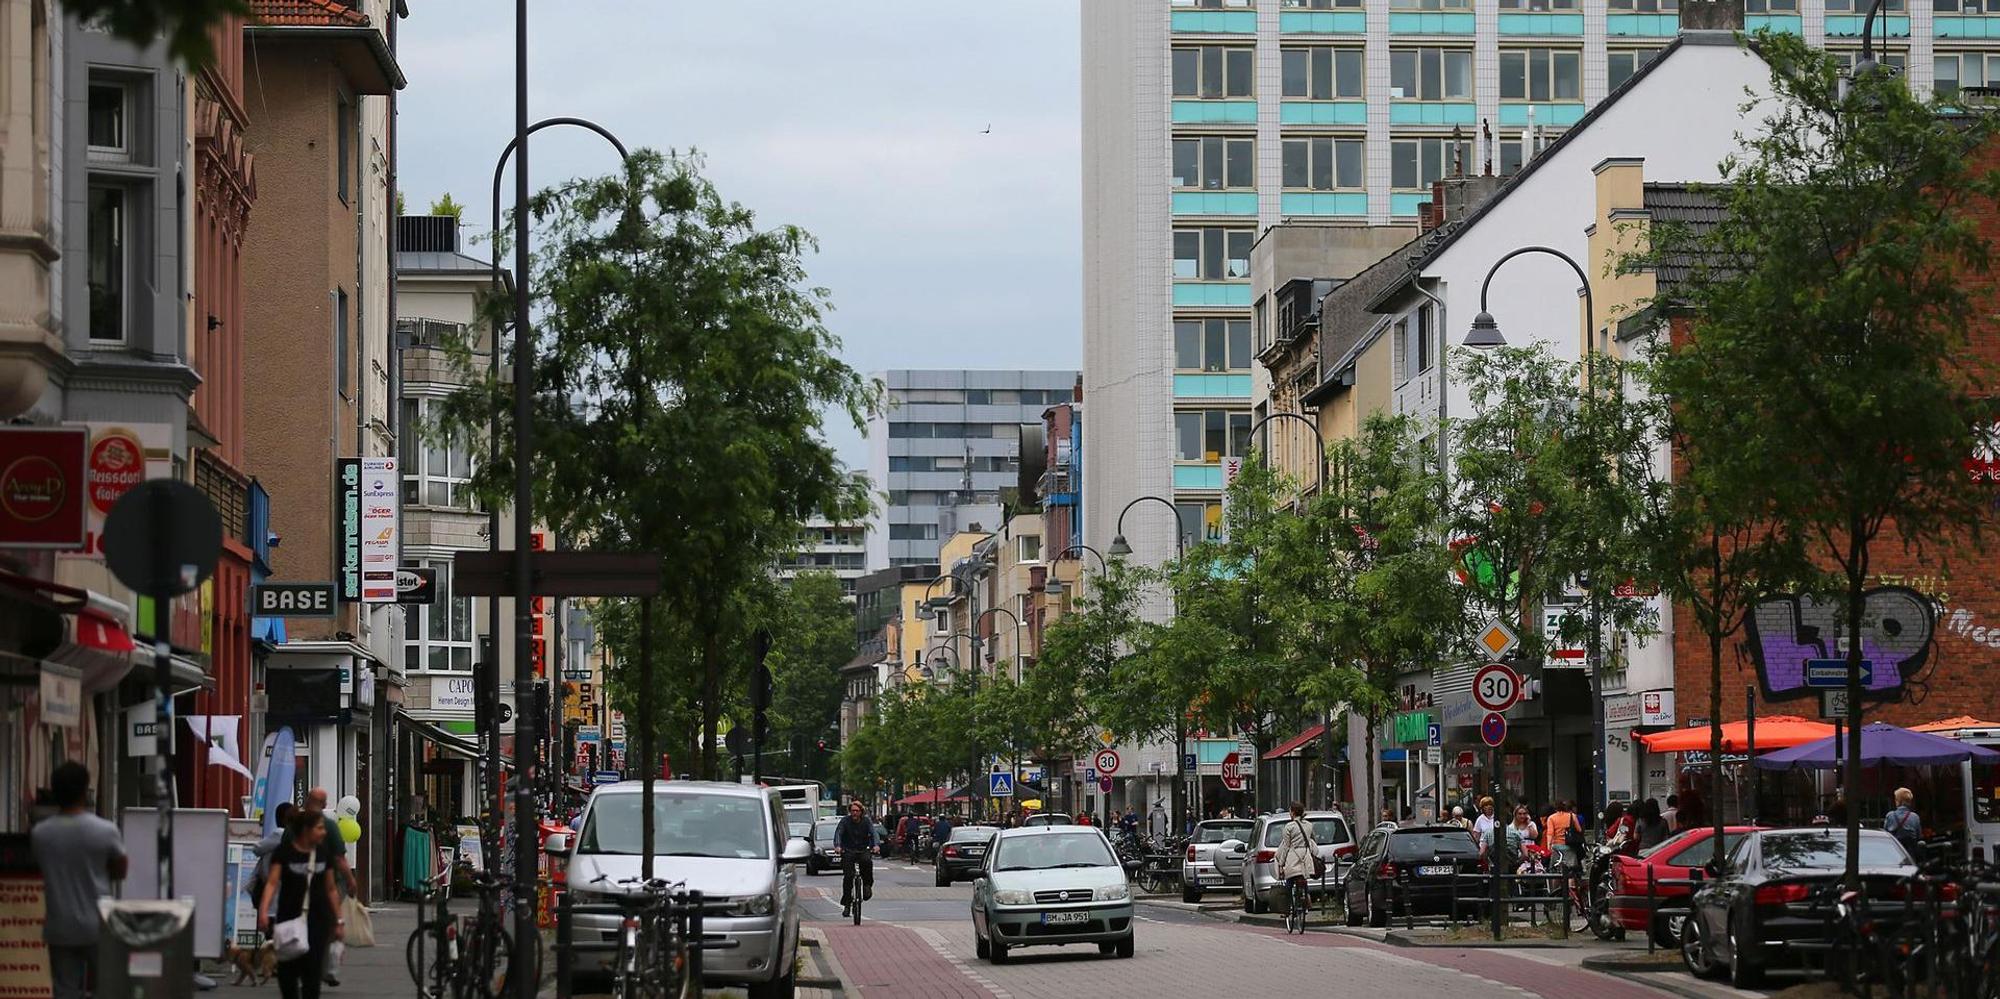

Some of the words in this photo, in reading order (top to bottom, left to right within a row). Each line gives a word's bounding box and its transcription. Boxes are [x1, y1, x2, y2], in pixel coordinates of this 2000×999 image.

[1229, 460, 1237, 482] ANK
[263, 590, 327, 609] BASE
[1483, 677, 1509, 699] 30
[1430, 726, 1437, 746] P
[1607, 734, 1629, 752] 275
[1100, 756, 1115, 768] 30
[1086, 770, 1093, 780] P
[1224, 763, 1242, 779] STO
[1650, 770, 1666, 778] 277
[1073, 912, 1088, 921] 951
